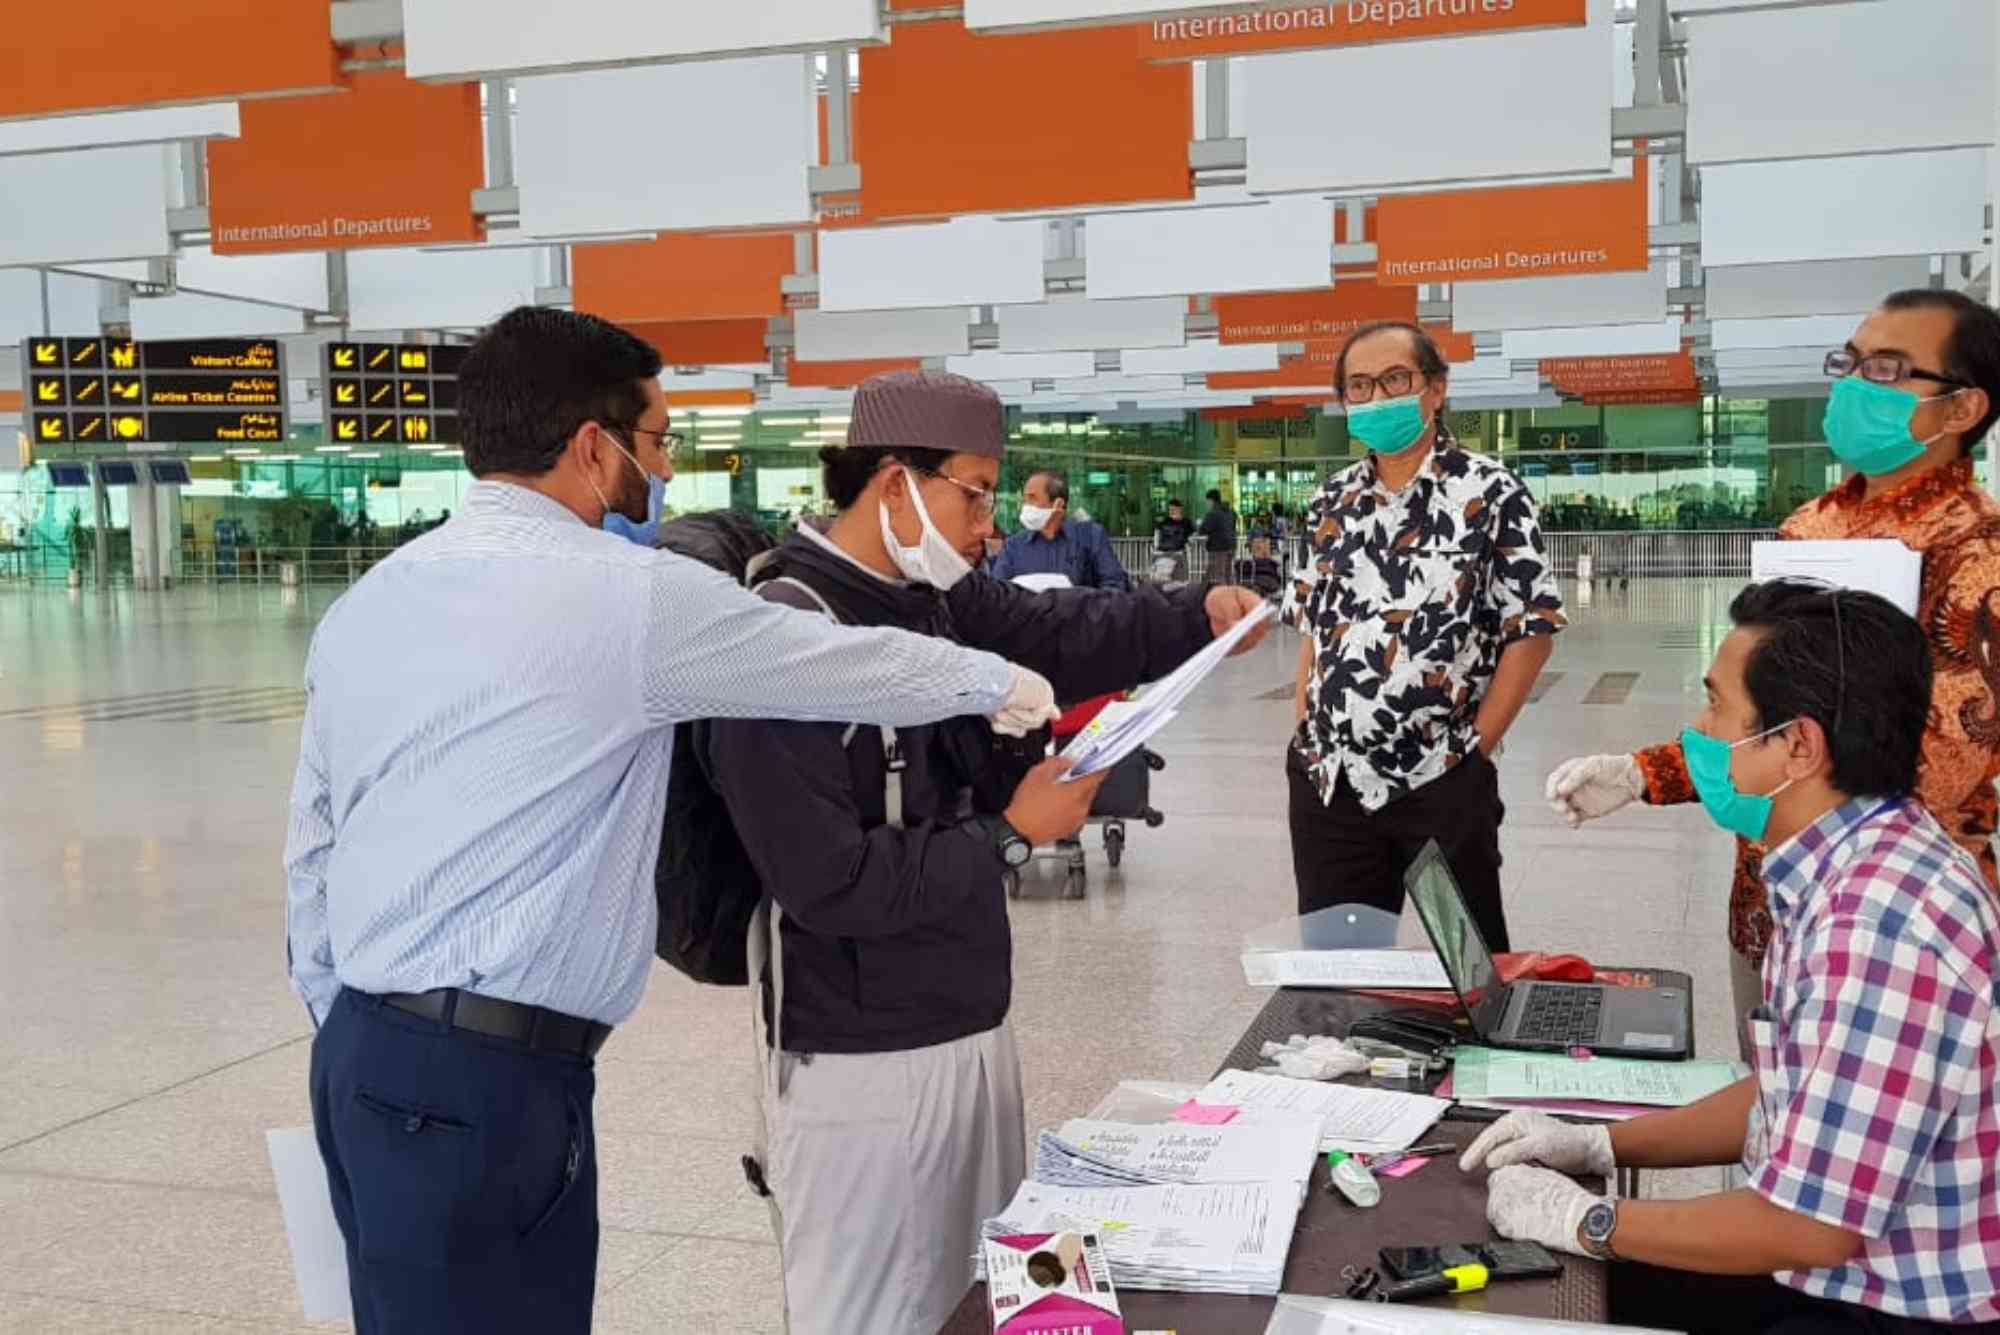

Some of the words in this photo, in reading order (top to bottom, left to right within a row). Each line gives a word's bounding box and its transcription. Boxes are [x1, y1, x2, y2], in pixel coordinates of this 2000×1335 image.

[1152, 4, 1335, 41] International
[1348, 0, 1514, 25] Departures
[217, 220, 328, 242] International
[334, 214, 432, 239] Departures
[1386, 253, 1499, 276] International
[1505, 248, 1608, 268] Departures
[1313, 318, 1360, 333] Depart
[152, 392, 188, 402] Airline
[191, 392, 225, 402] Ticket
[217, 426, 245, 438] Food
[247, 428, 278, 438] Court
